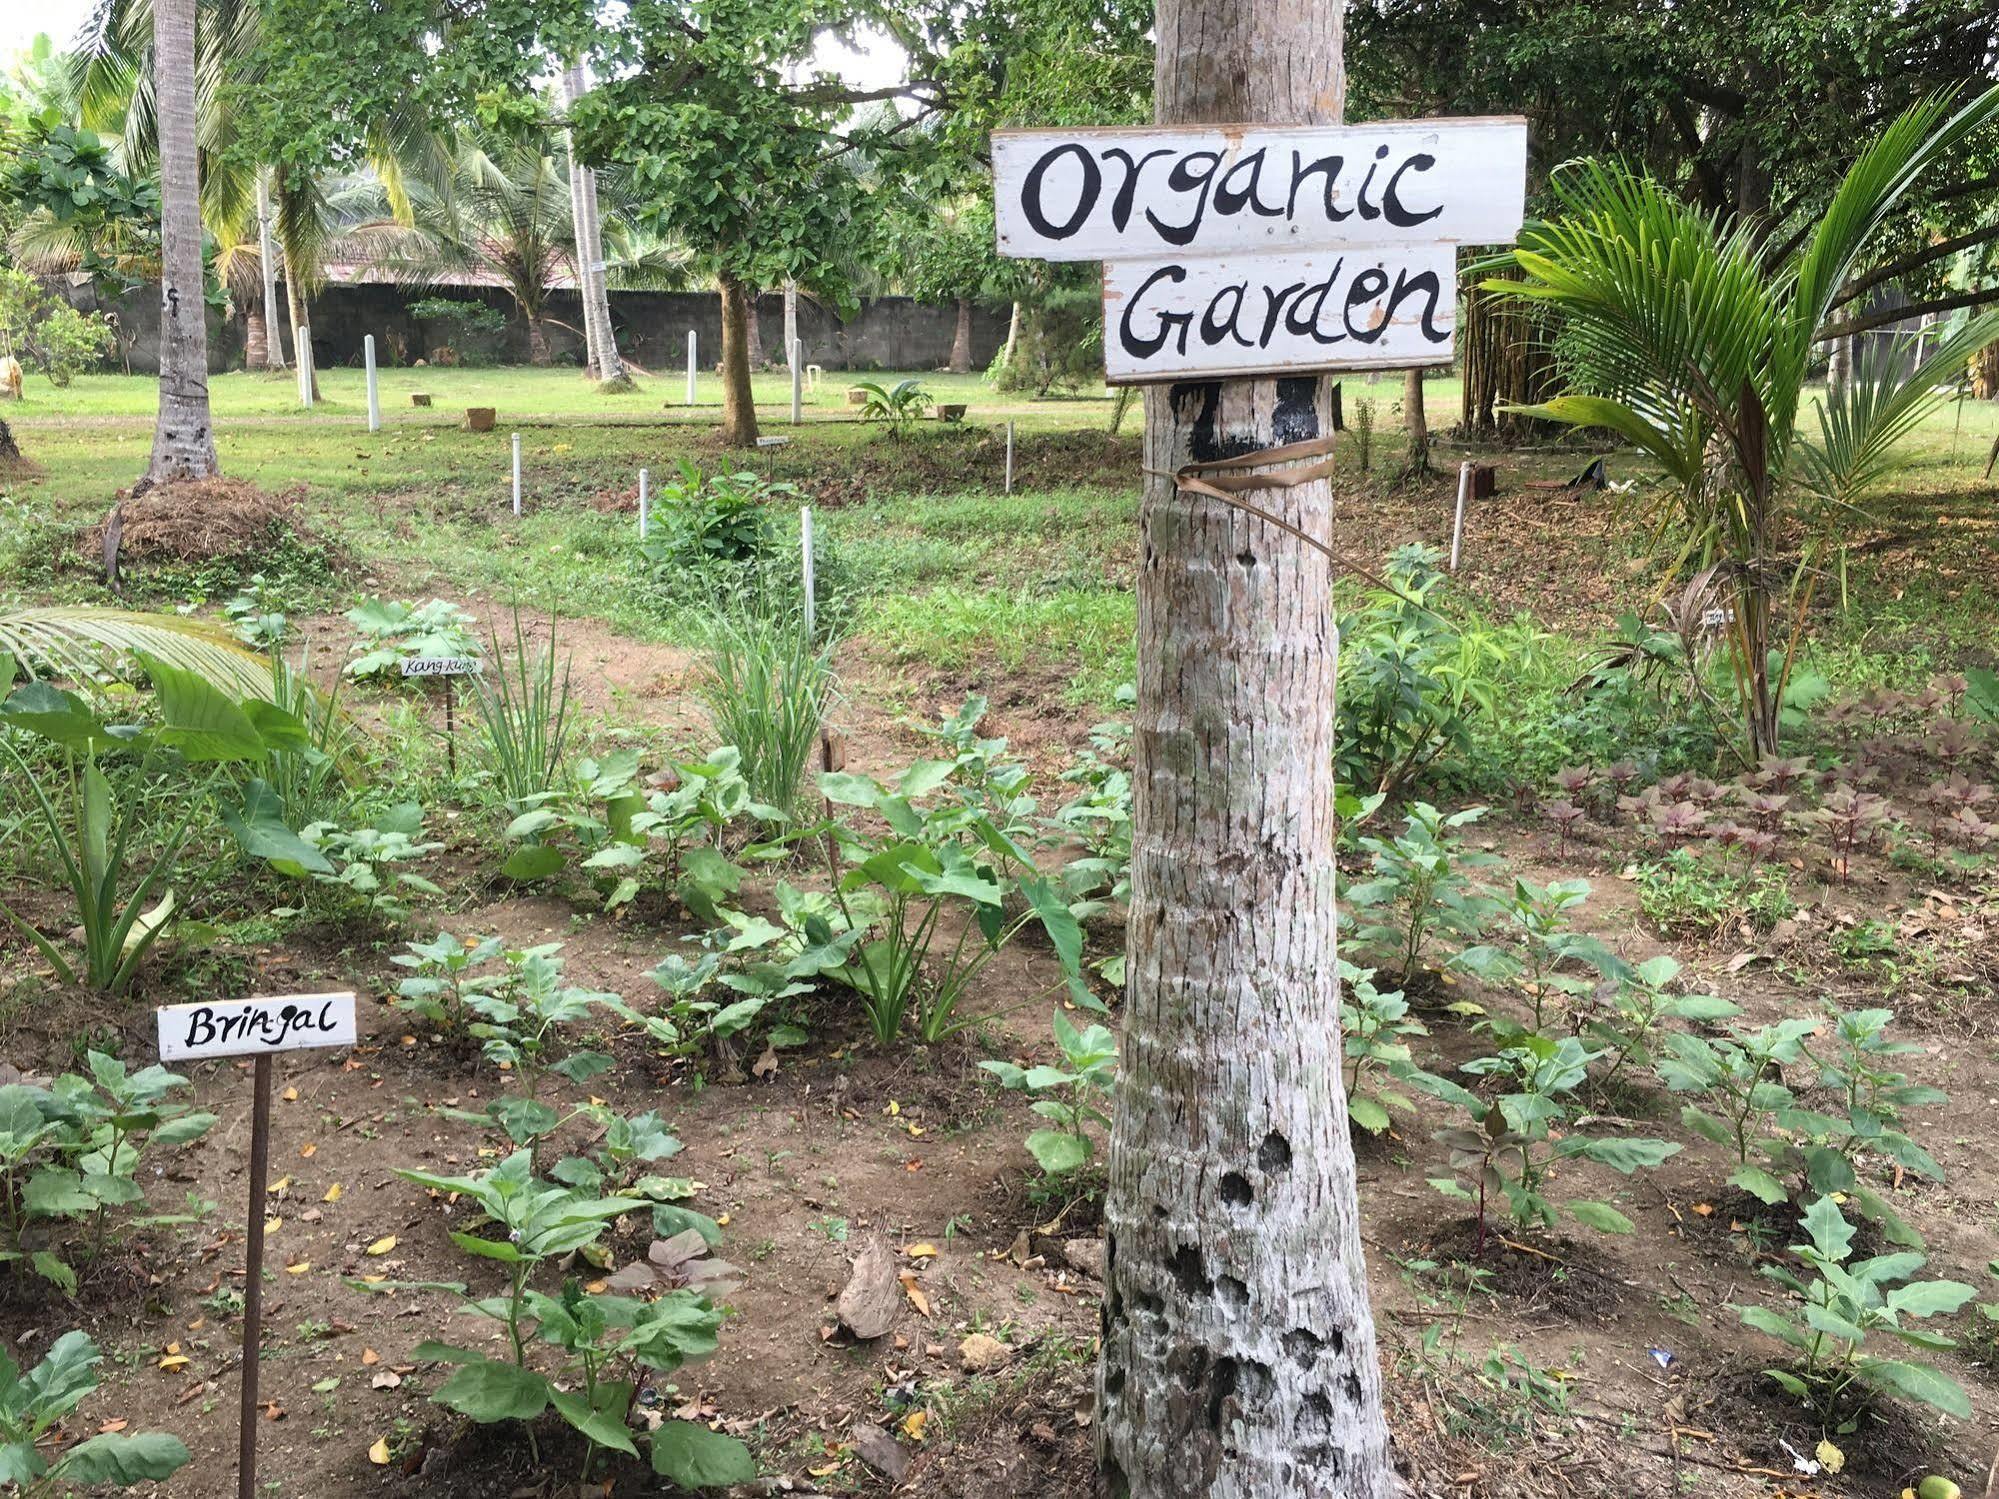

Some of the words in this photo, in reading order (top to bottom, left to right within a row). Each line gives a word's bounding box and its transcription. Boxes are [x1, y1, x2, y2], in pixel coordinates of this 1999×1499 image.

[1021, 143, 1443, 246] Organic
[1120, 257, 1452, 359] Garden
[184, 1001, 338, 1048] Bringal
